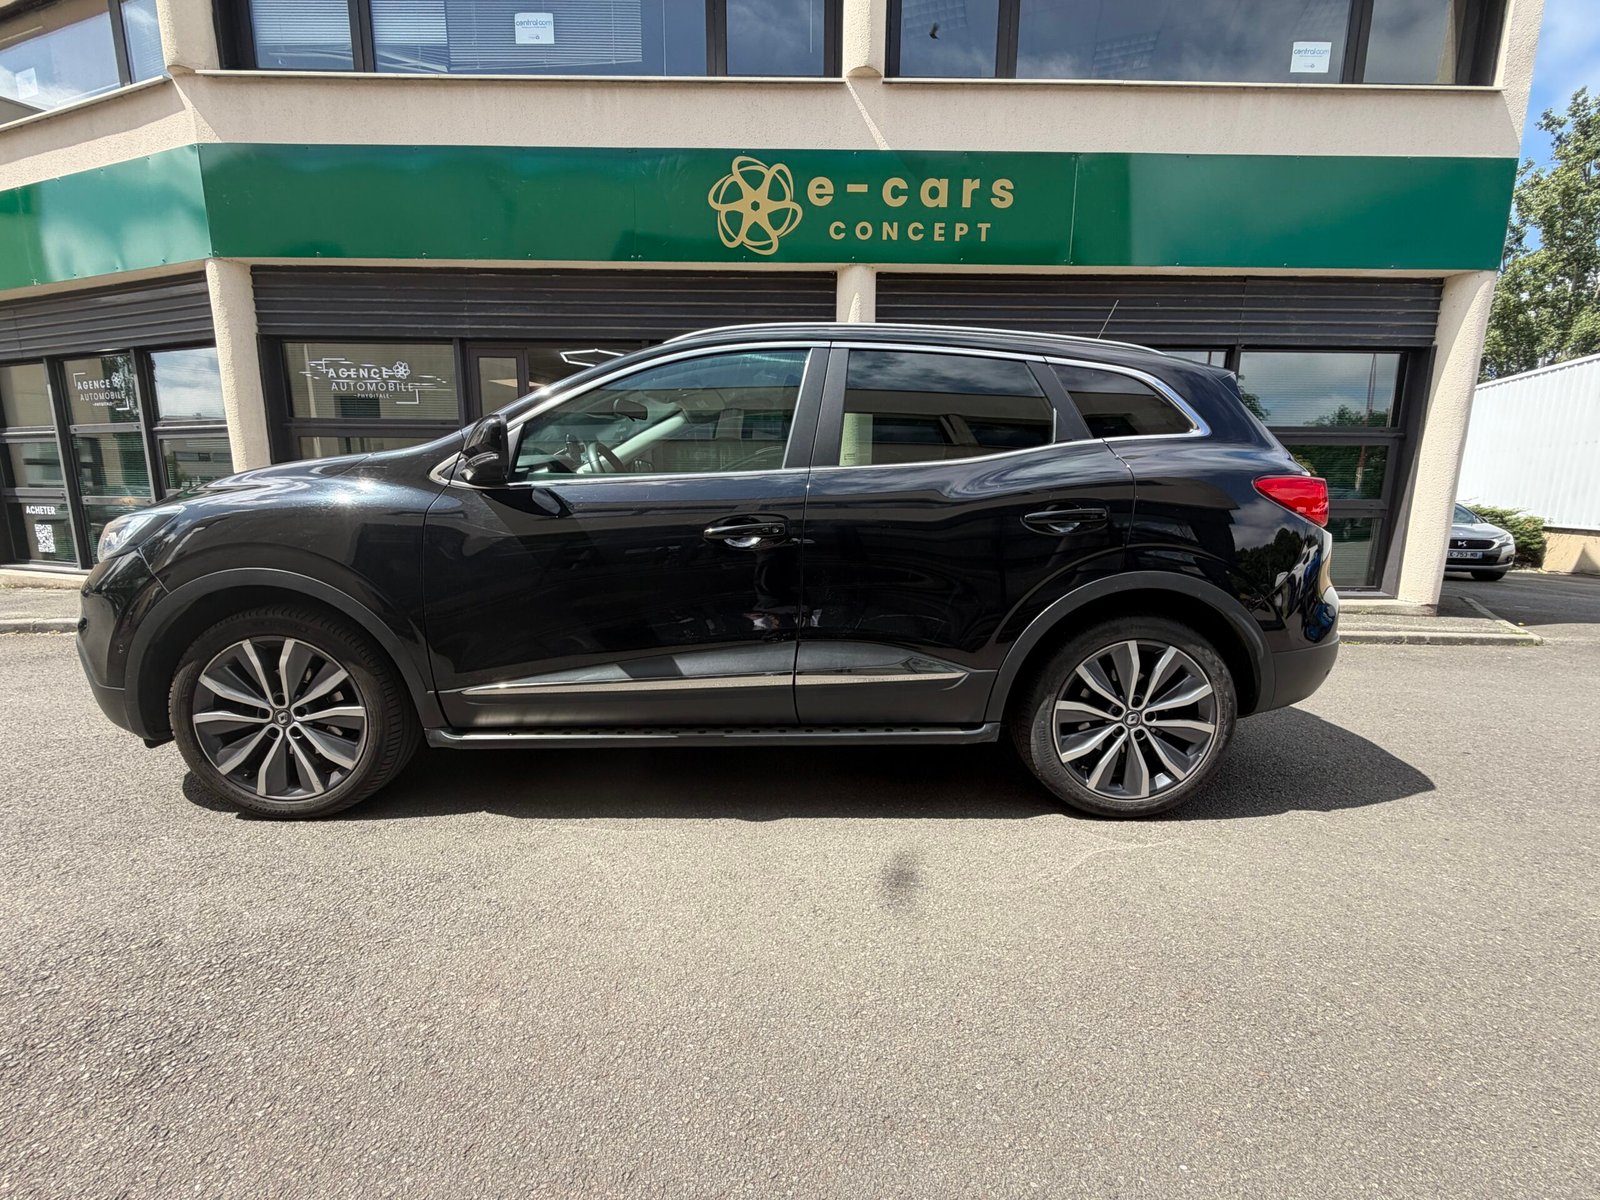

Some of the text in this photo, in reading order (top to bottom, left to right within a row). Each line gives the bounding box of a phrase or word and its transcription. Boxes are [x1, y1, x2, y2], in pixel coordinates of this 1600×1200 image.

[807, 176, 1015, 209] e-cars
[829, 221, 991, 242] CONCEPT
[328, 367, 390, 378] AGENCE
[77, 379, 111, 390] AGENCE
[331, 382, 414, 392] AUTOMOBILE
[80, 390, 126, 401] AUTOMOBILE
[26, 505, 56, 515] ACHETER
